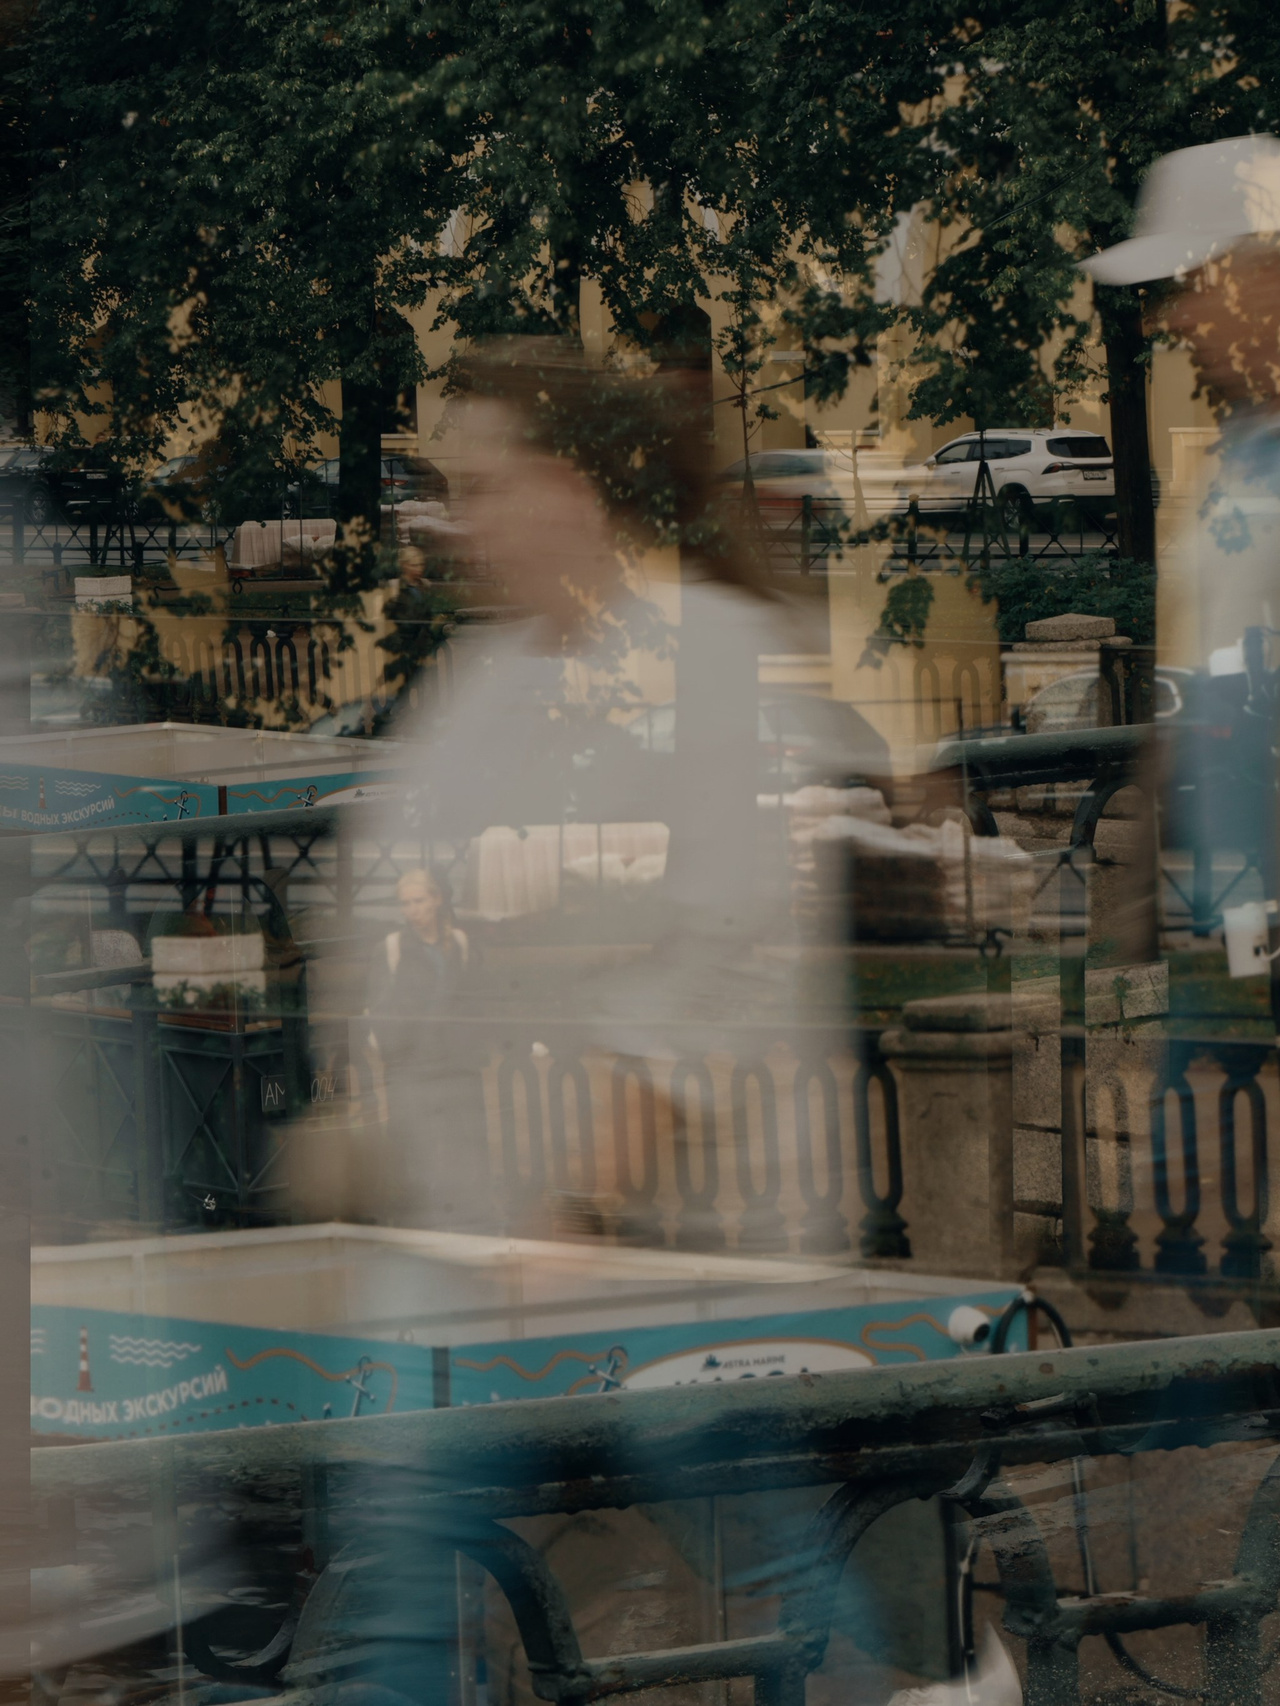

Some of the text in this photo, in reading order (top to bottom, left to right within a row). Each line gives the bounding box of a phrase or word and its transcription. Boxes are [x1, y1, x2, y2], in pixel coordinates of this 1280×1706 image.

[21, 810, 60, 827] ВОДНЫХ
[61, 795, 115, 824] ЭКСКУРСИЙ
[311, 1076, 338, 1103] 004
[722, 1355, 785, 1369] ASTRA MARINE
[122, 1364, 228, 1422] ЭКСКУРСИЙ
